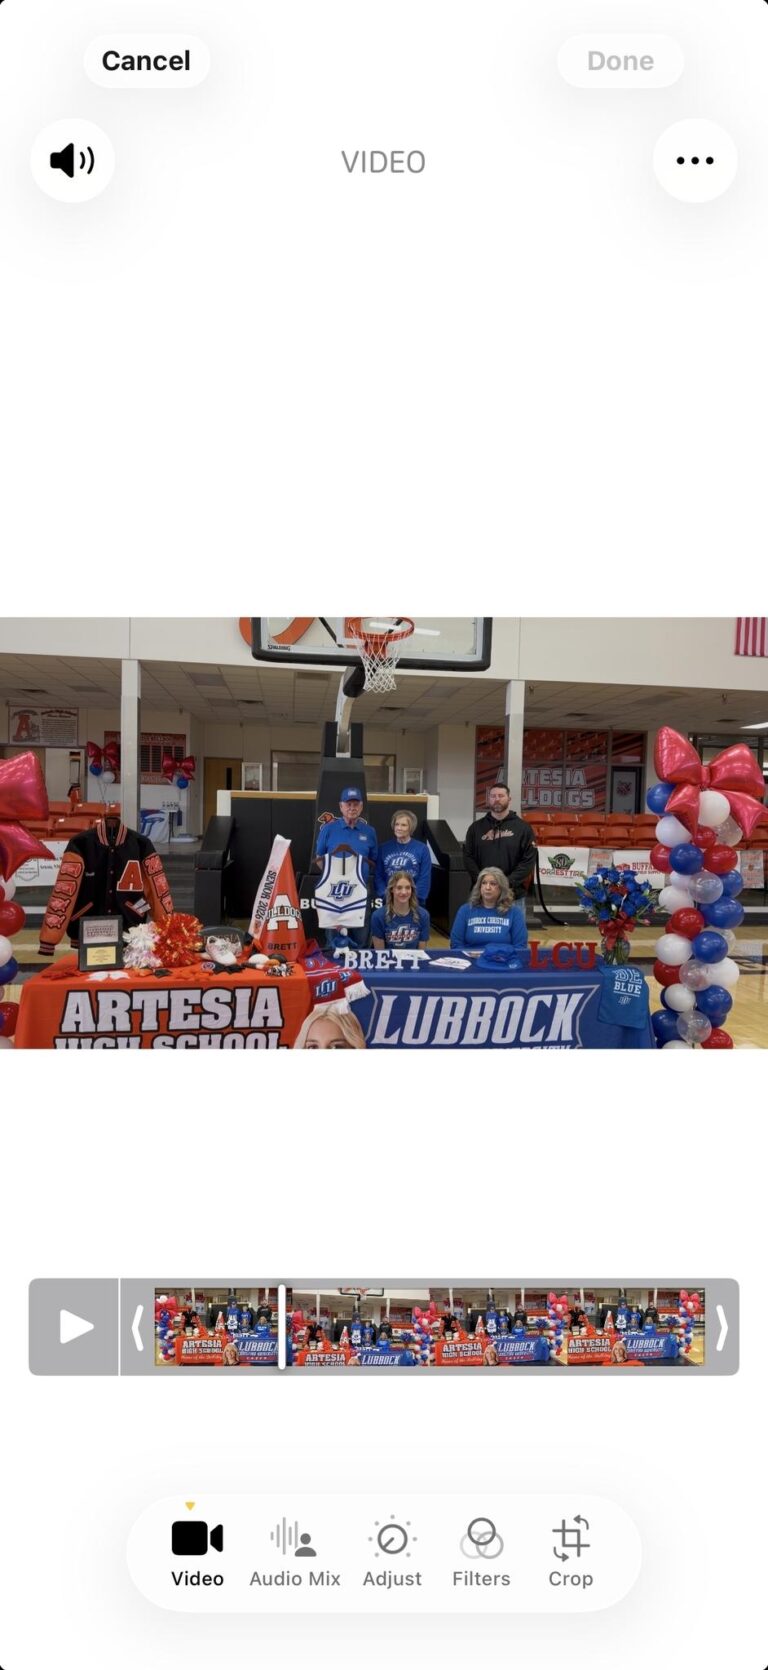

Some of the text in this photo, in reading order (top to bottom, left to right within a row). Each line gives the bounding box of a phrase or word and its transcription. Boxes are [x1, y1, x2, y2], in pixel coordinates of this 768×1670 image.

[102, 49, 190, 72] Cancel
[588, 50, 655, 71] Done
[341, 150, 426, 174] VIDEO
[116, 859, 144, 891] A
[260, 870, 277, 900] SENIOR
[254, 900, 269, 921] 2026
[267, 942, 297, 951] BRETT
[527, 940, 599, 971] LCU
[344, 949, 421, 970] BRETT
[613, 980, 642, 995] BLUE
[60, 986, 285, 1034] ARTESIA
[370, 992, 585, 1045] LUBBOCK
[183, 1340, 222, 1348] ARTESIA
[442, 1342, 482, 1352] ARTESIA
[569, 1338, 611, 1347] ARTESIA
[306, 1354, 346, 1362] ARTESIA
[170, 1570, 225, 1587] Video
[249, 1570, 341, 1587] Audio Mix
[362, 1570, 422, 1590] Adjust
[453, 1570, 511, 1587] Filters
[548, 1570, 594, 1590] Crop
